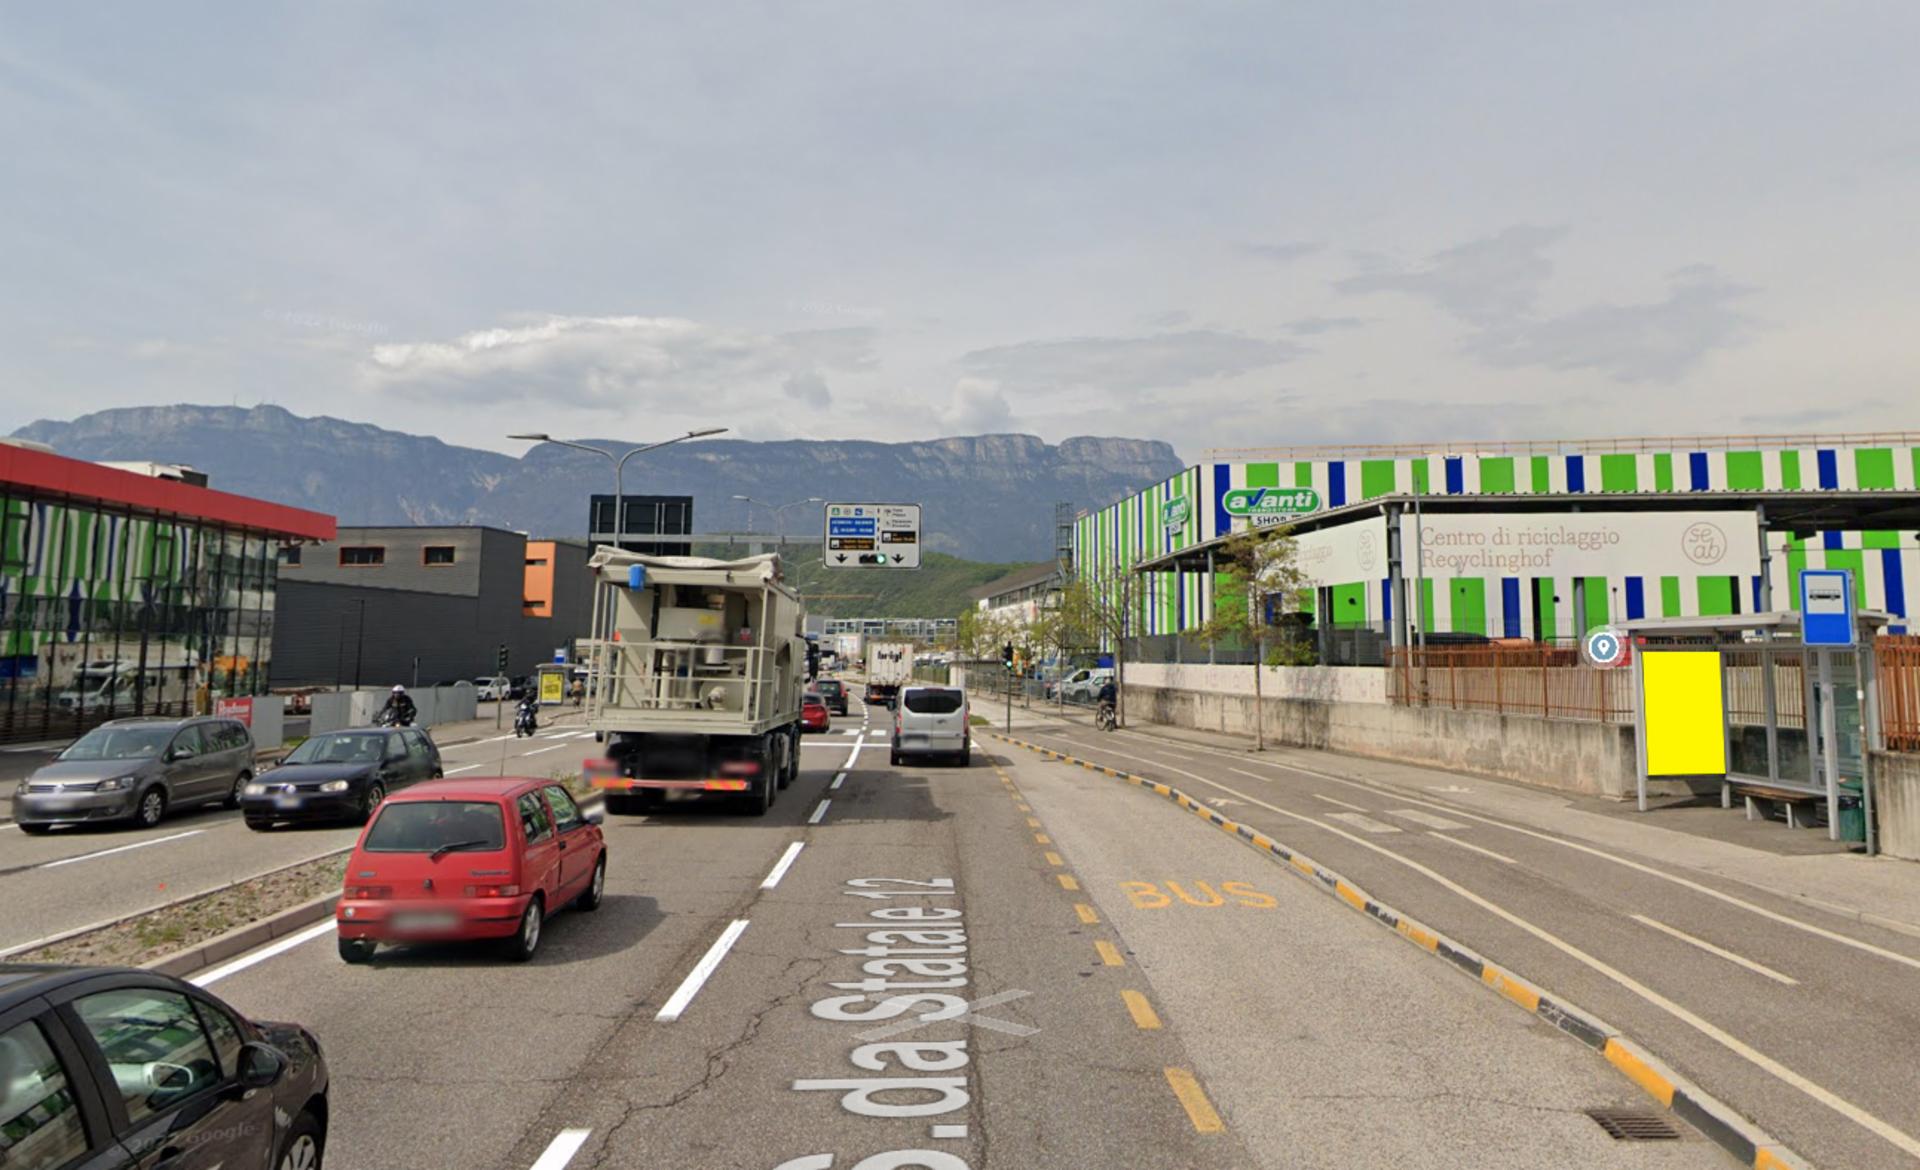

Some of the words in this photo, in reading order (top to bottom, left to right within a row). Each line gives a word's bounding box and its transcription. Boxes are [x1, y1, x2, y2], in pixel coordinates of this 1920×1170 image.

[1229, 488, 1313, 509] avanti
[1420, 526, 1486, 546] Centro
[1492, 527, 1509, 546] di
[1517, 526, 1620, 551] riciclaggio
[1420, 548, 1555, 573] Recyclinghof
[1118, 879, 1279, 910] BUS
